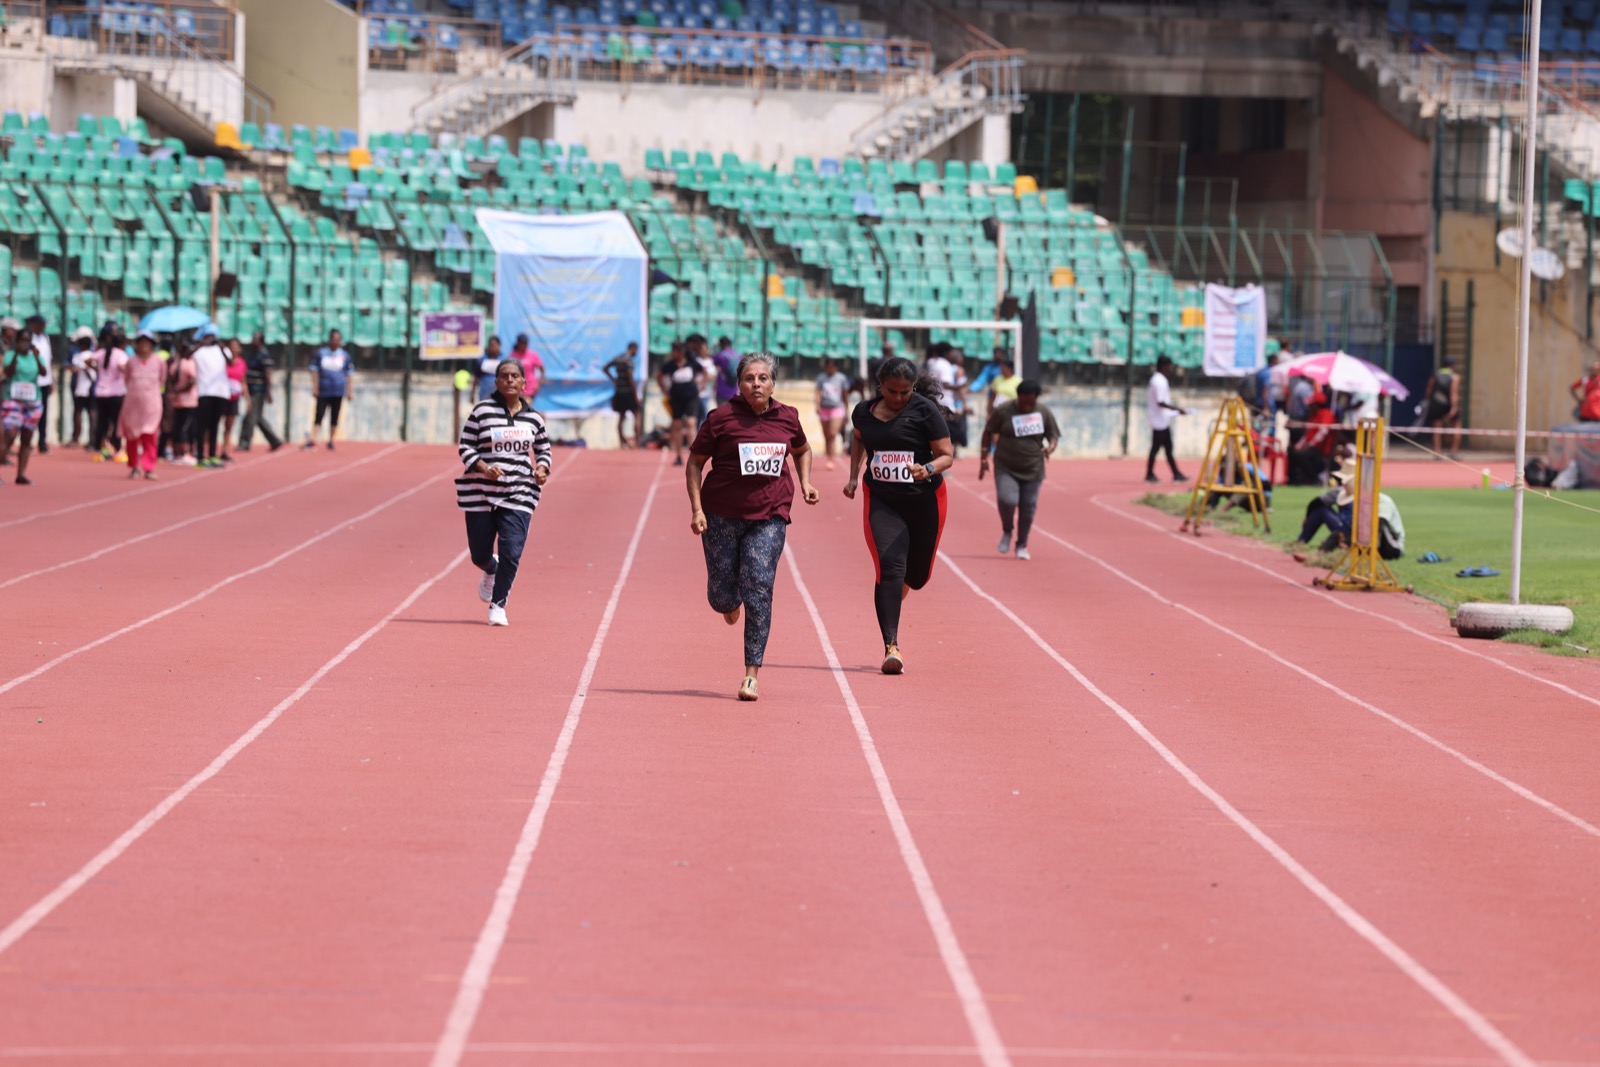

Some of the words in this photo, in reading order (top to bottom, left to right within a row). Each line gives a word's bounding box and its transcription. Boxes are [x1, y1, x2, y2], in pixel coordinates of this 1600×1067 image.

[494, 440, 530, 453] 6008
[754, 446, 785, 456] CDMAA
[881, 454, 912, 464] CDMAA
[873, 466, 910, 480] 6010
